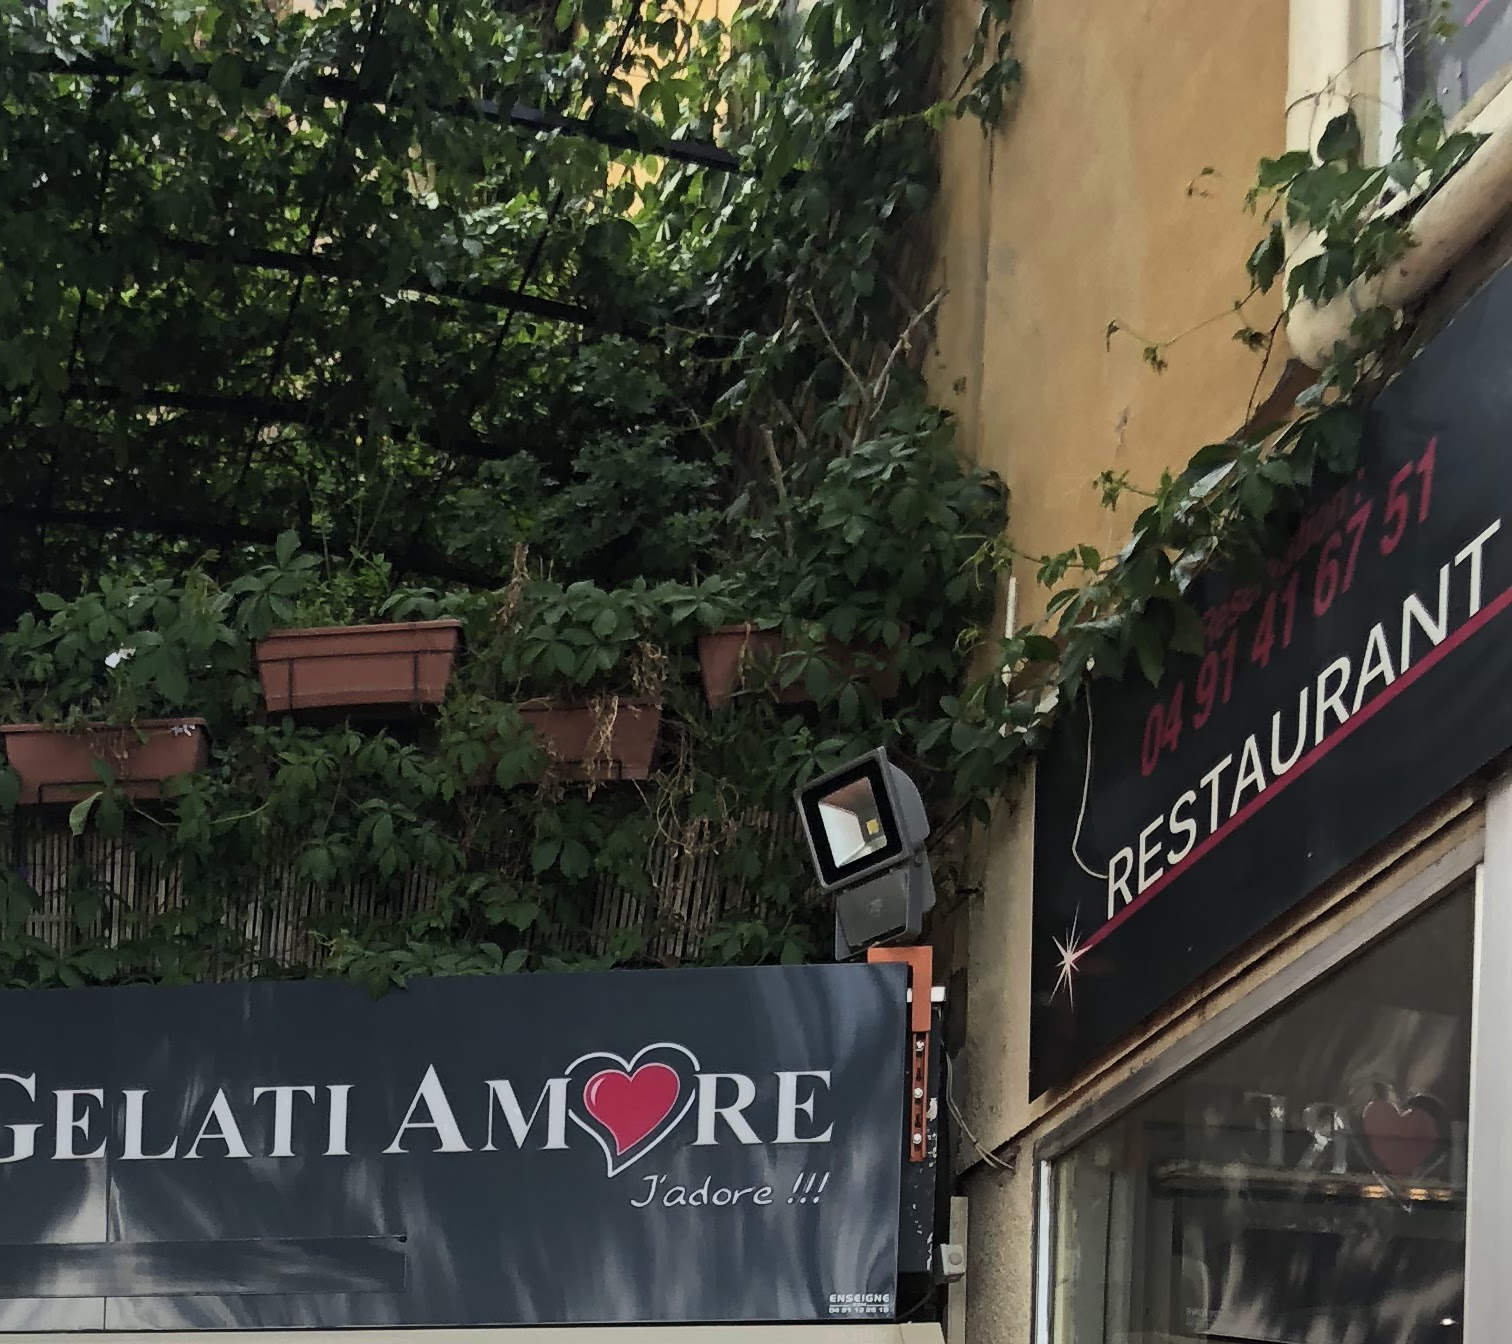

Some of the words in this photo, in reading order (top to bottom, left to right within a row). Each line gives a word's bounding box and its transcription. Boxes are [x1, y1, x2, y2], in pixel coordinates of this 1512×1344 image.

[1142, 682, 1183, 776] 04
[1193, 634, 1238, 729] 91
[1314, 498, 1372, 617] 67
[1380, 436, 1438, 556] 51
[1107, 519, 1501, 919] RESTAURANT
[631, 1174, 773, 1208] J'adore
[787, 1171, 830, 1205] !!!
[829, 1294, 890, 1302] ENSEIGNE
